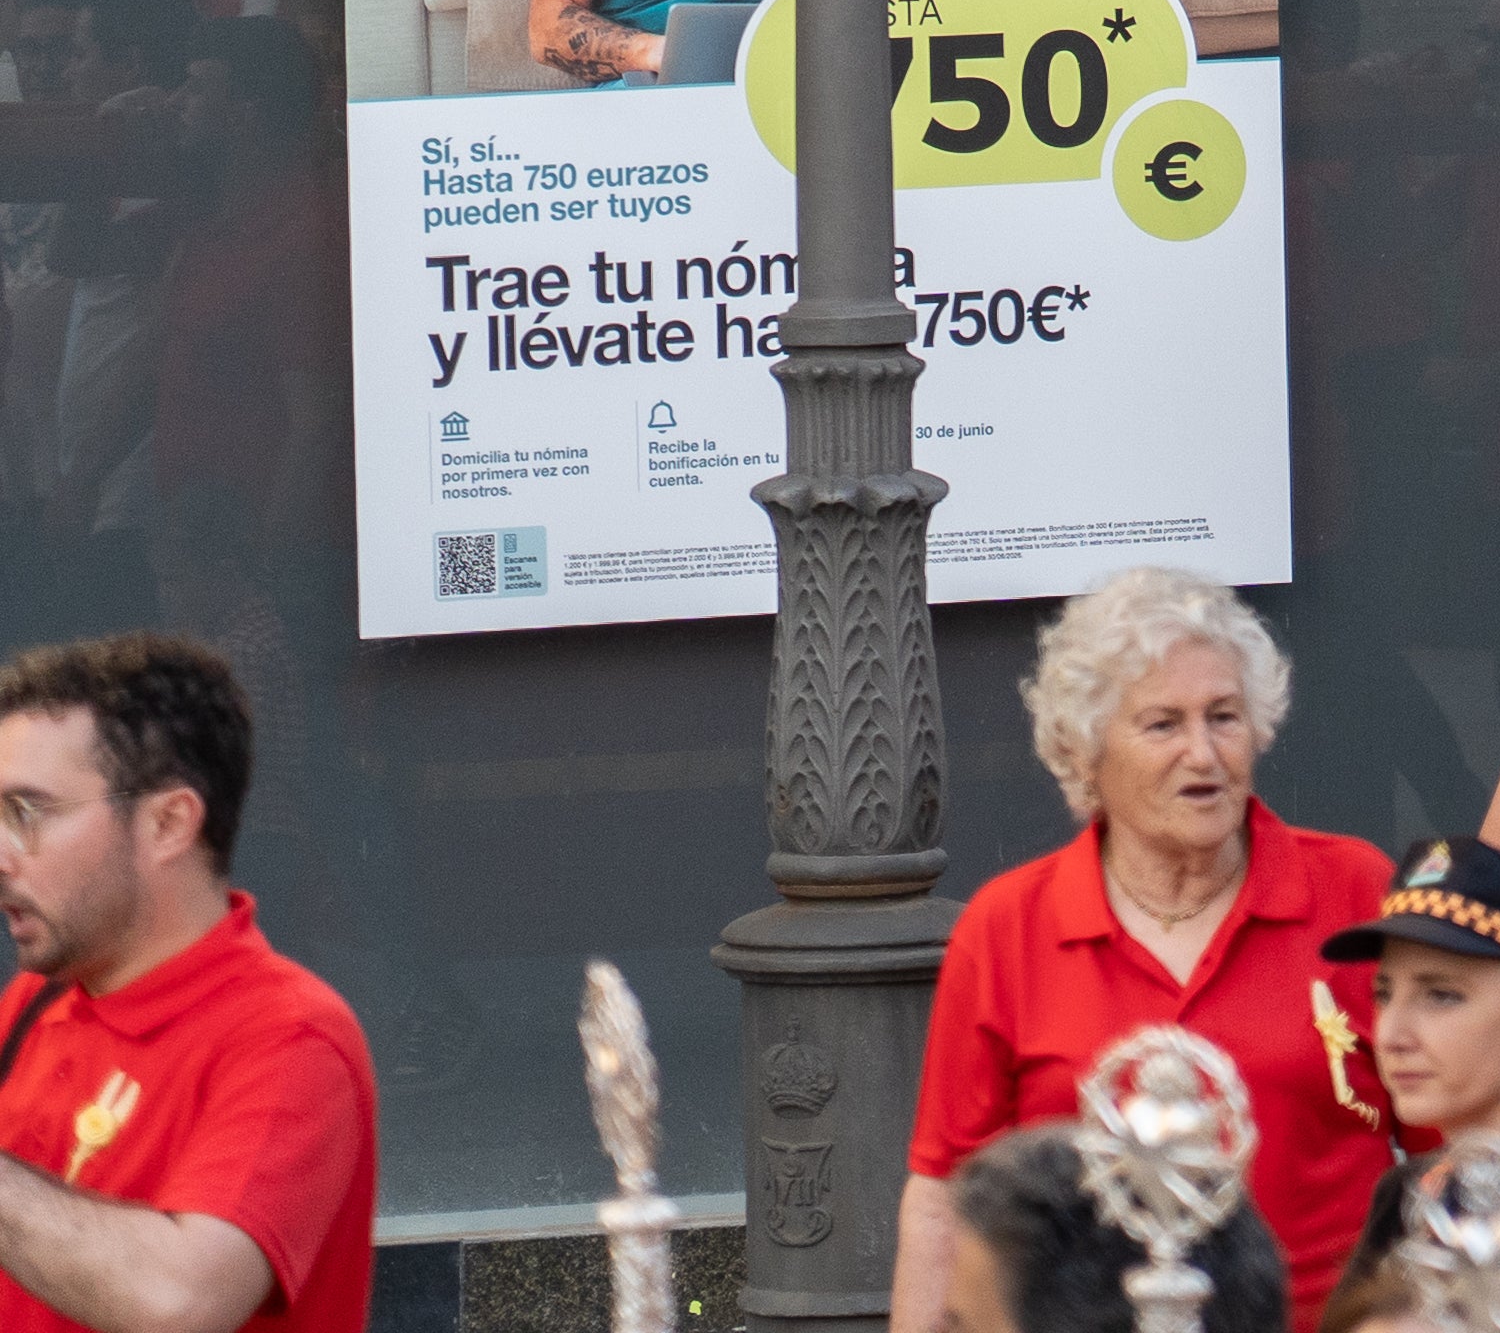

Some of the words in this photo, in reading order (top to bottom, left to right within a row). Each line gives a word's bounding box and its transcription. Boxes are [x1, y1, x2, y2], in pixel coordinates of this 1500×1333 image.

[421, 137, 460, 169] Sí,
[469, 135, 521, 162] sí...
[423, 168, 513, 196] Hasta
[523, 163, 577, 192] 750
[586, 161, 709, 189] eurazos
[1144, 140, 1205, 202] €
[424, 197, 540, 233] pueden
[550, 197, 599, 221] ser
[607, 193, 692, 223] tuyos
[425, 254, 571, 312] Trae
[588, 251, 653, 304] tu
[428, 331, 468, 389] y
[487, 311, 695, 372] llévate
[915, 425, 933, 440] 30
[936, 424, 955, 439] de
[957, 422, 994, 441] junio
[441, 450, 510, 467] Domicilia
[514, 449, 530, 463] tu
[533, 446, 589, 462] nómina
[648, 439, 699, 455] Recibe
[703, 438, 717, 452] la
[648, 454, 739, 471] bonificación
[743, 455, 761, 466] en
[764, 452, 780, 465] tu
[442, 471, 467, 485] por
[471, 467, 529, 483] primera
[532, 467, 558, 479] vez
[561, 464, 590, 477] con
[648, 474, 703, 488] cuenta.
[442, 485, 512, 500] nosotros.
[504, 566, 522, 576] para
